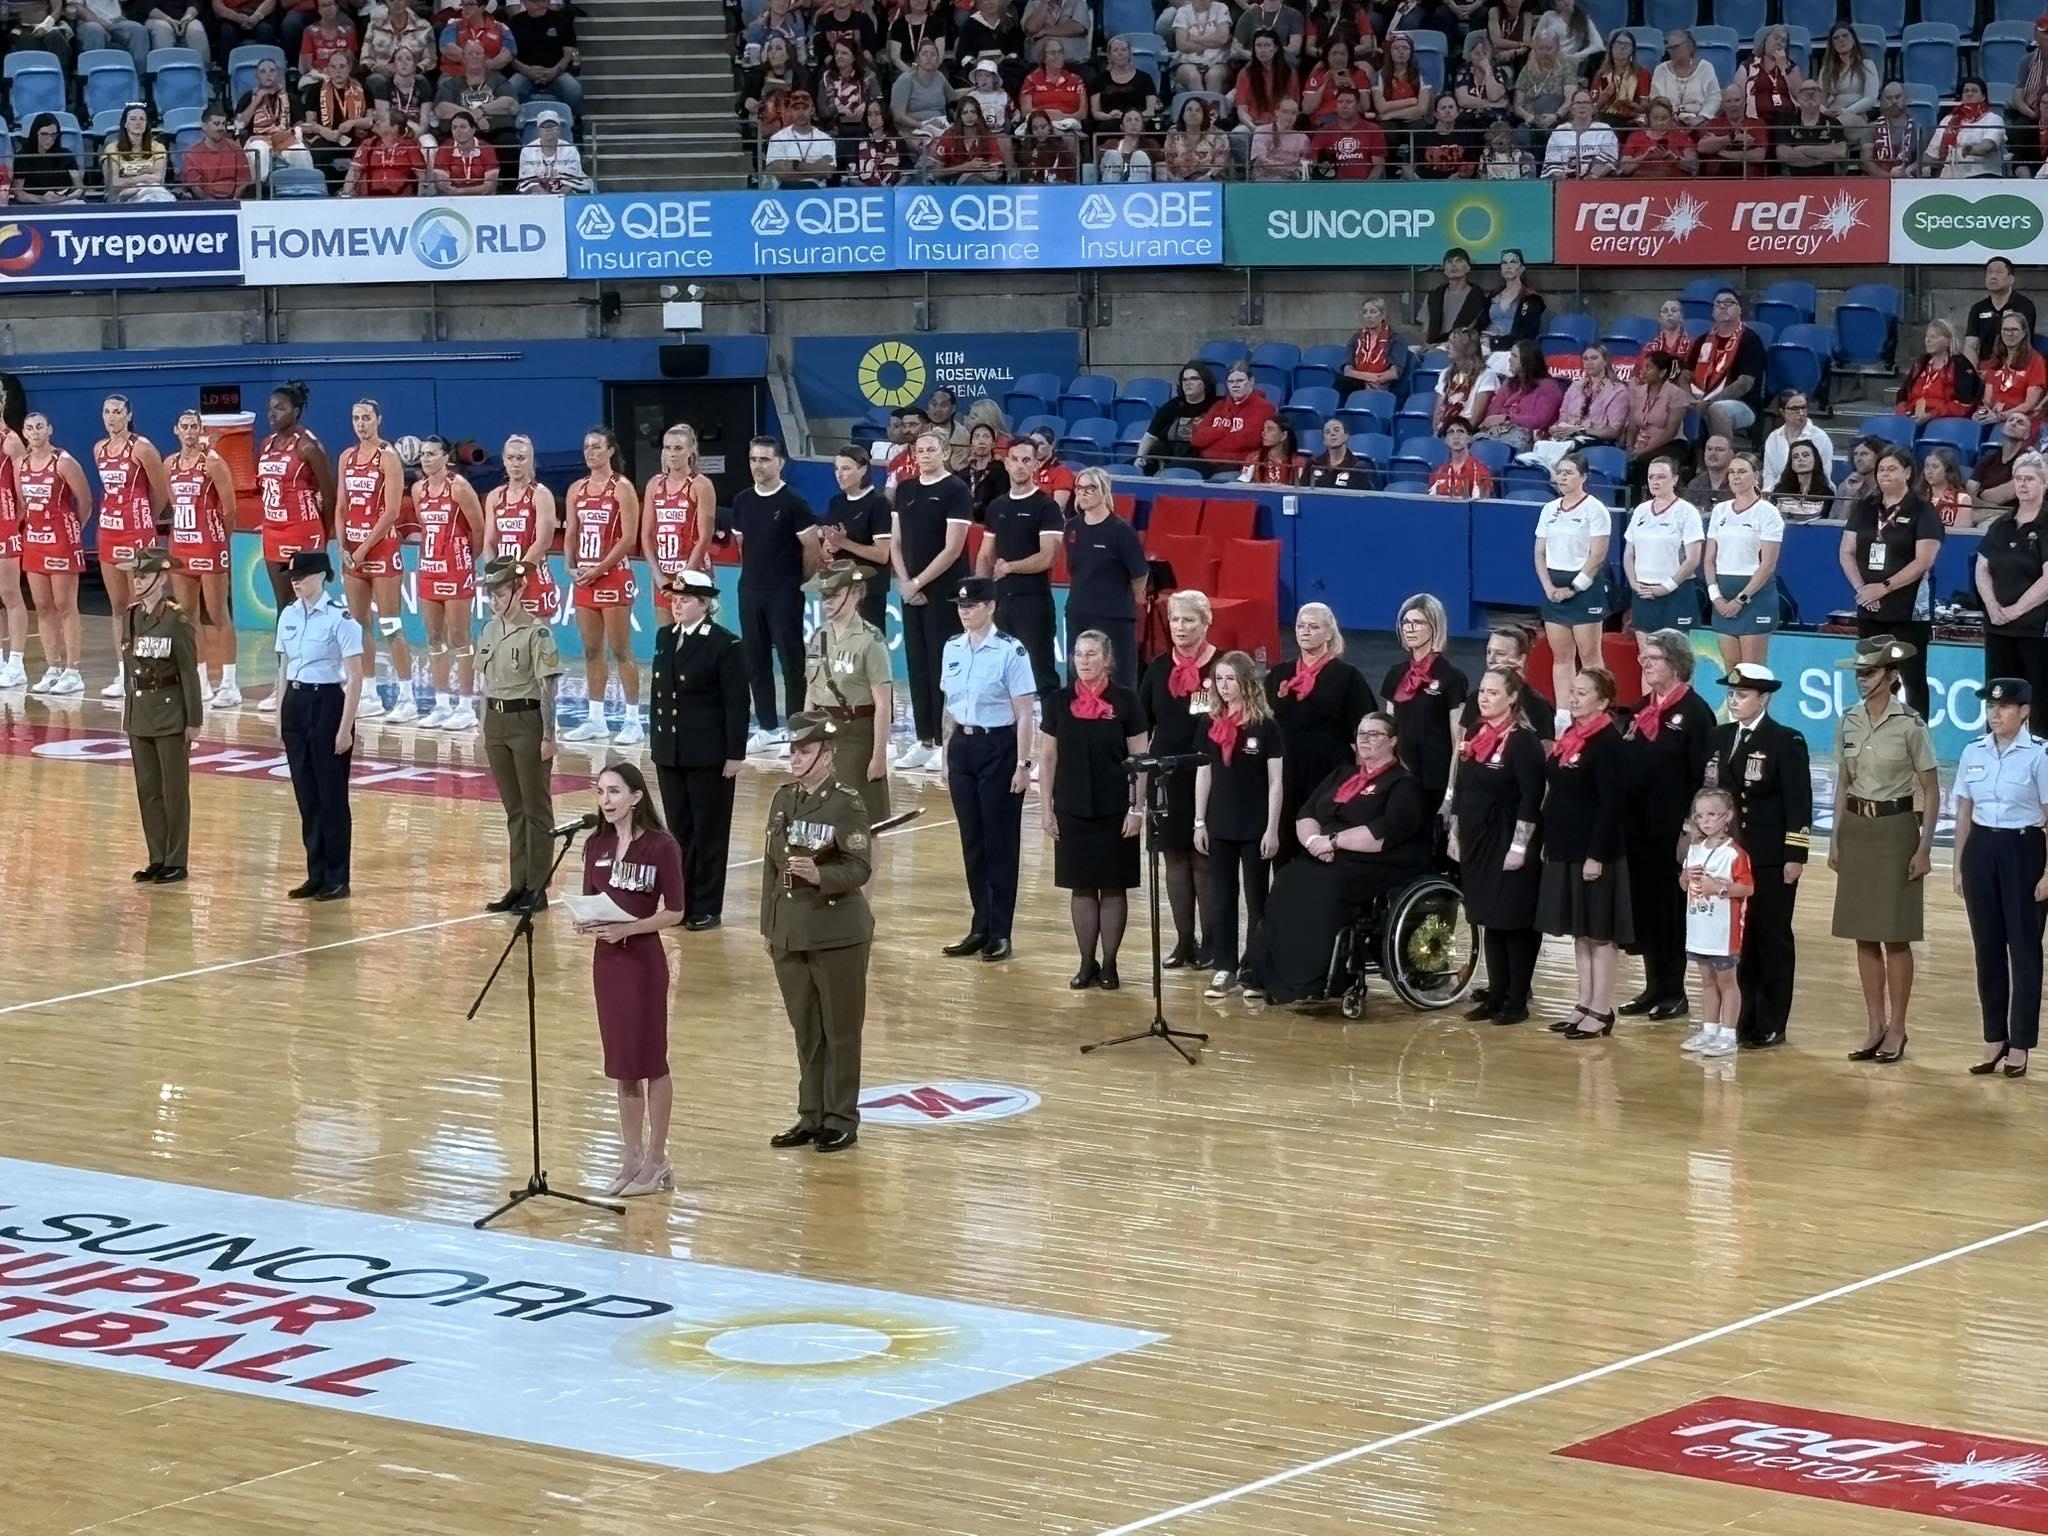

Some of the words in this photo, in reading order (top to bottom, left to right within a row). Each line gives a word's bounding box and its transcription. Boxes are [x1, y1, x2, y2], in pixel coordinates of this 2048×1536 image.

[622, 200, 712, 239] QBE
[796, 195, 885, 235] QBE
[950, 192, 1039, 231] QBE
[1123, 190, 1212, 228] QBE
[1268, 208, 1435, 239] SUNCORP
[1575, 196, 1648, 233] red
[1731, 194, 1804, 232] red
[1914, 210, 2032, 236] Specsavers
[50, 228, 228, 264] Tyrepower
[579, 244, 712, 270] Insurance
[754, 240, 885, 266] Insurance
[907, 235, 1039, 263] Insurance
[1081, 233, 1211, 260] Insurance
[1589, 231, 1664, 257] energy
[1746, 229, 1824, 255] energy
[935, 352, 965, 366] KEN
[935, 367, 1014, 382] ROSEWALL
[309, 534, 320, 549] 7
[392, 551, 402, 570] 6
[0, 1213, 674, 1320] SUNCORP
[0, 1250, 376, 1335] UPER
[1670, 1418, 1930, 1462] red
[1681, 1442, 1903, 1484] energy
